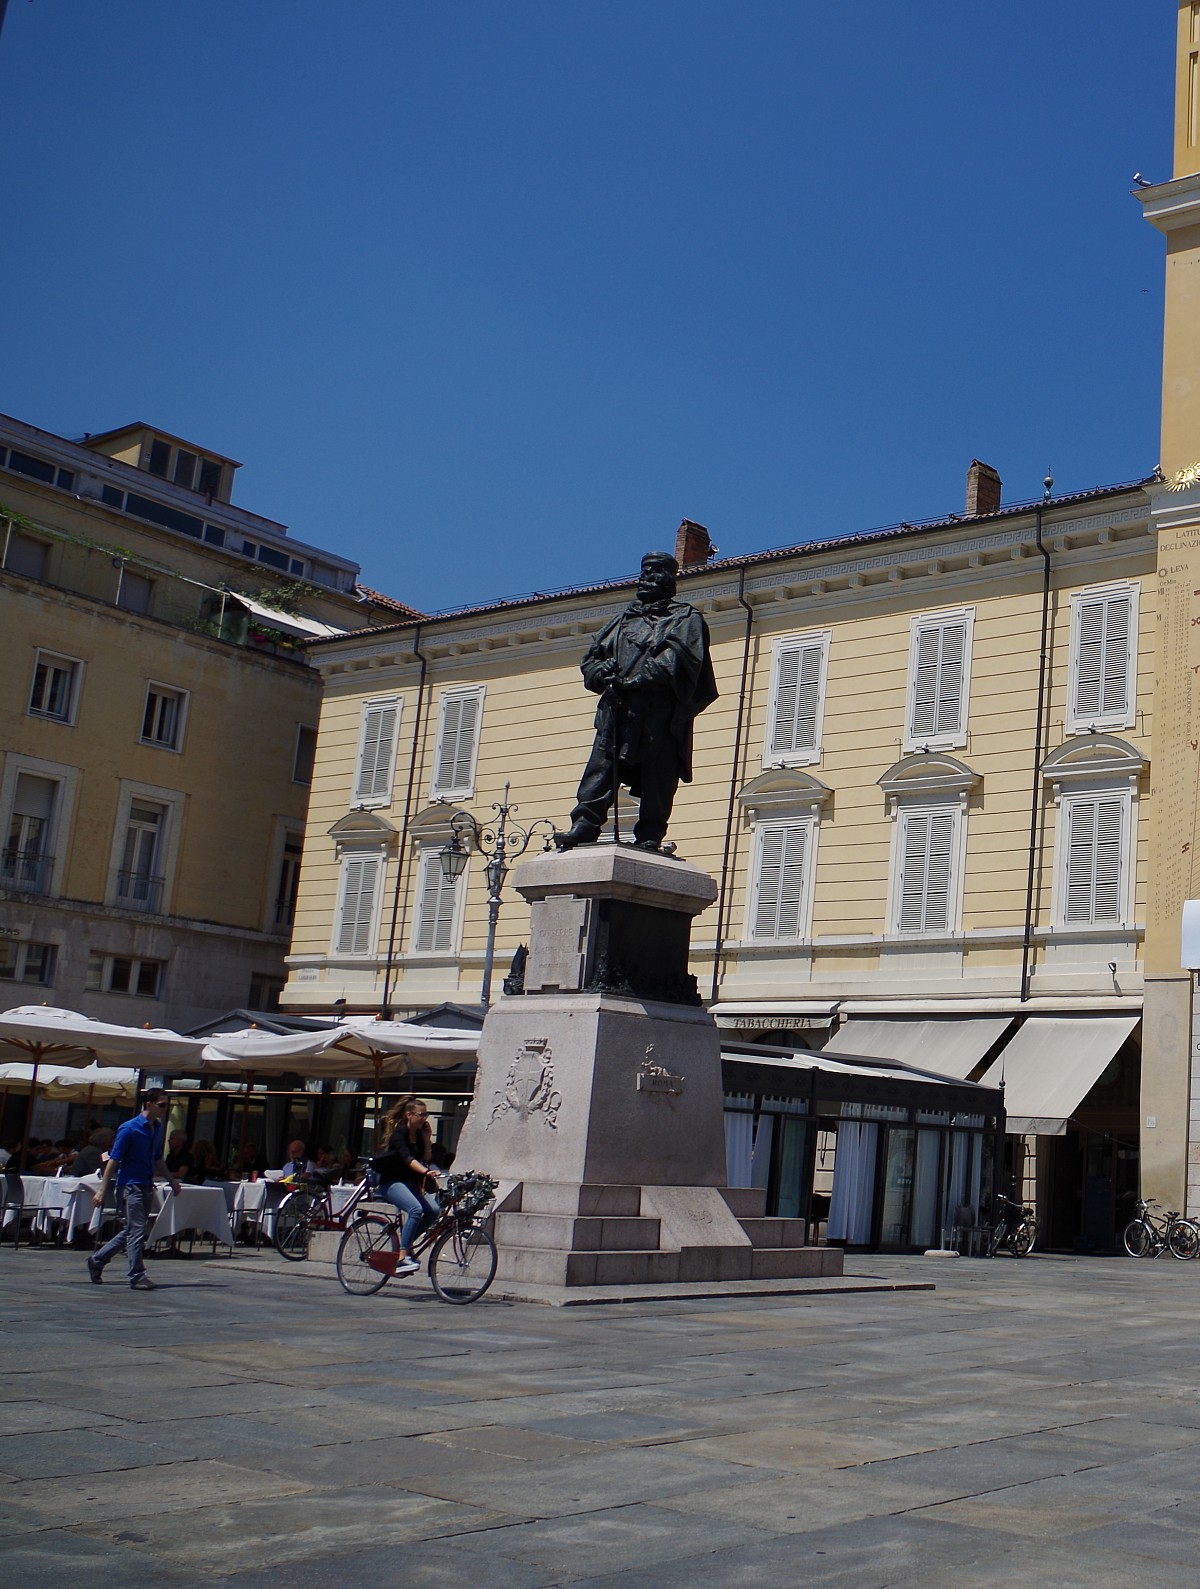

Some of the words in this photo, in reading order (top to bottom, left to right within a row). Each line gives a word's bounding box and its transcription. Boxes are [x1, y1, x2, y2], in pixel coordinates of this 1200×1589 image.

[1170, 564, 1189, 573] LEVA
[733, 1017, 812, 1028] TABACCHERIA
[652, 1078, 674, 1087] ROMA
